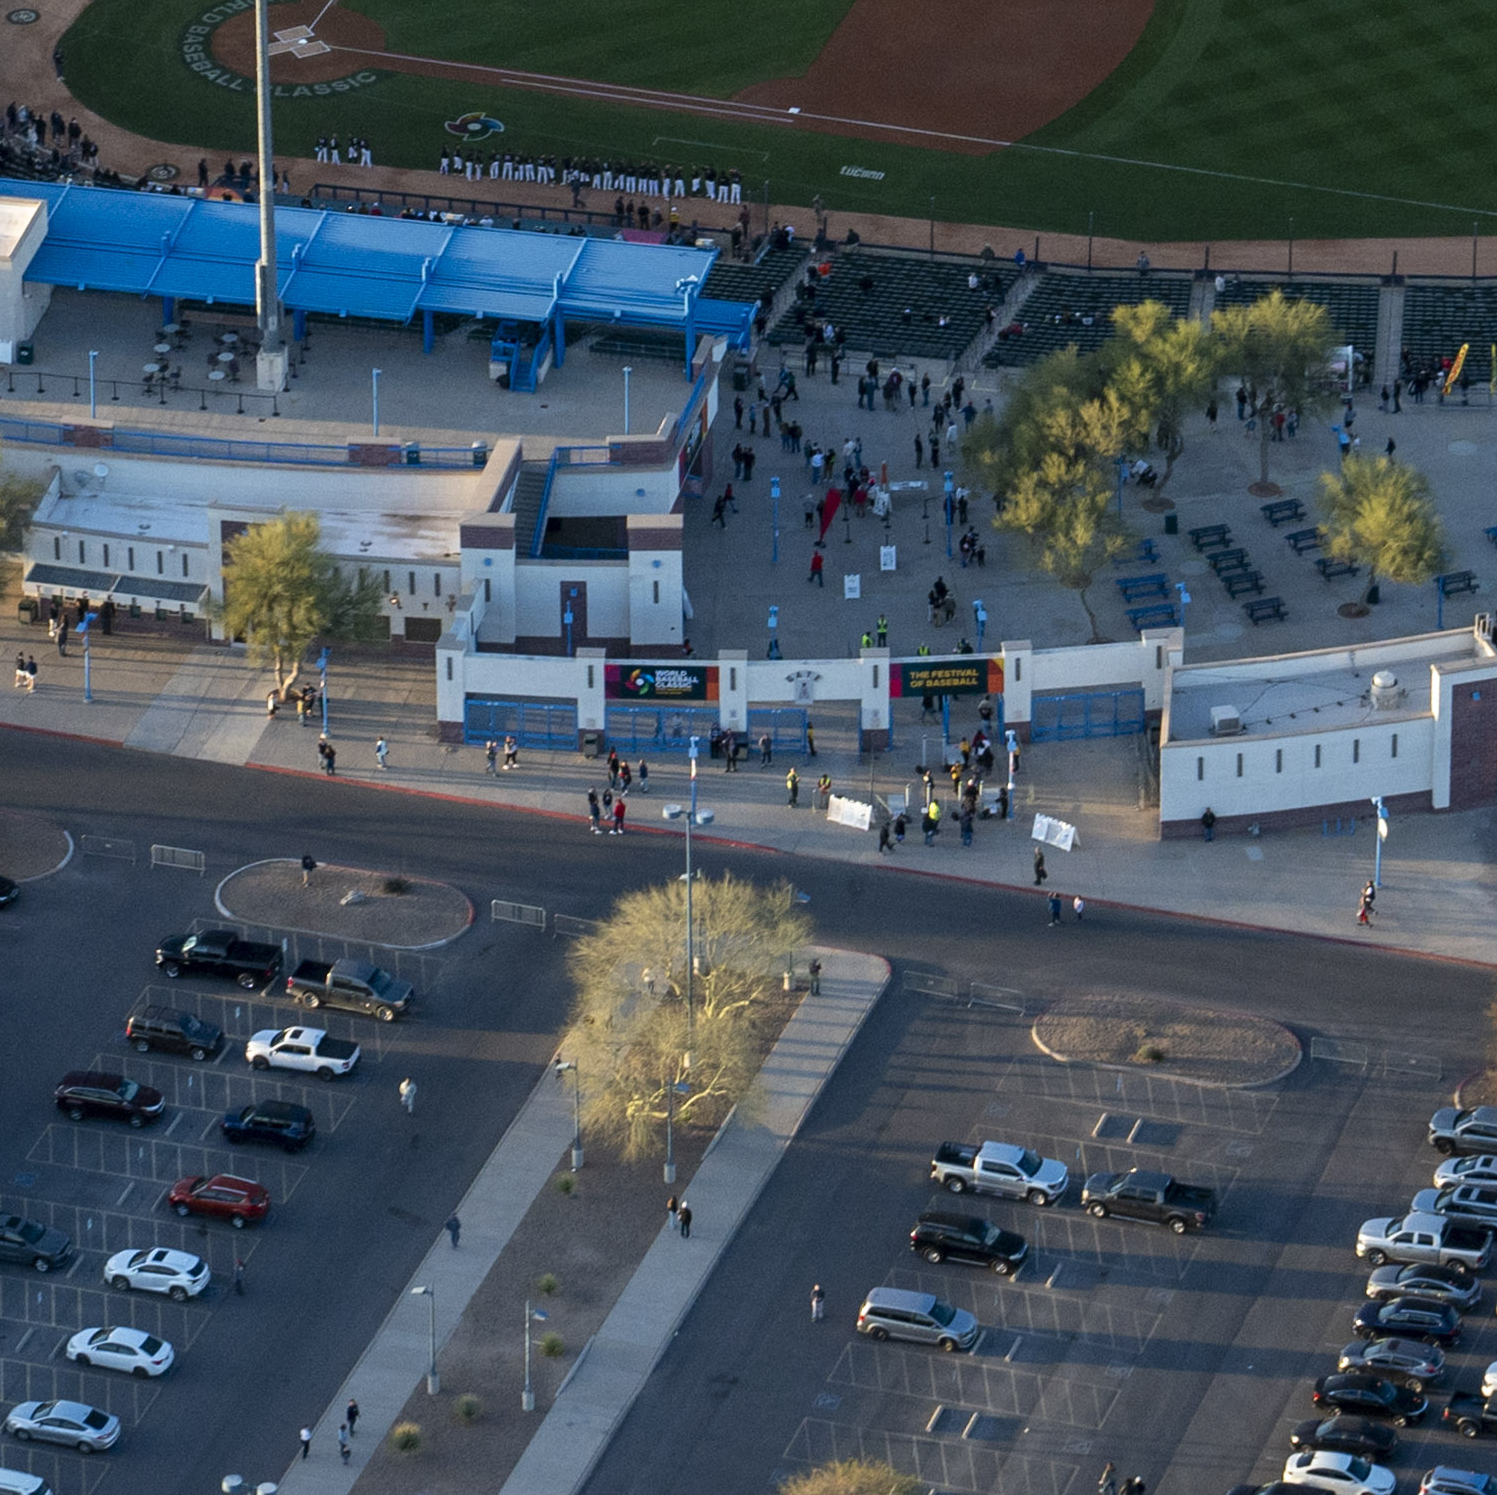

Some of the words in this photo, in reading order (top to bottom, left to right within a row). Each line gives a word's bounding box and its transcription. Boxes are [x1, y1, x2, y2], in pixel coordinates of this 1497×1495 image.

[182, 25, 243, 90] BASEBALL
[910, 670, 930, 679] THE
[931, 669, 979, 678] FESTIVAL
[655, 676, 700, 684] BASEBALL
[655, 681, 692, 689] CLASSIC
[910, 680, 925, 688] OF
[926, 678, 978, 687] BASEBALL
